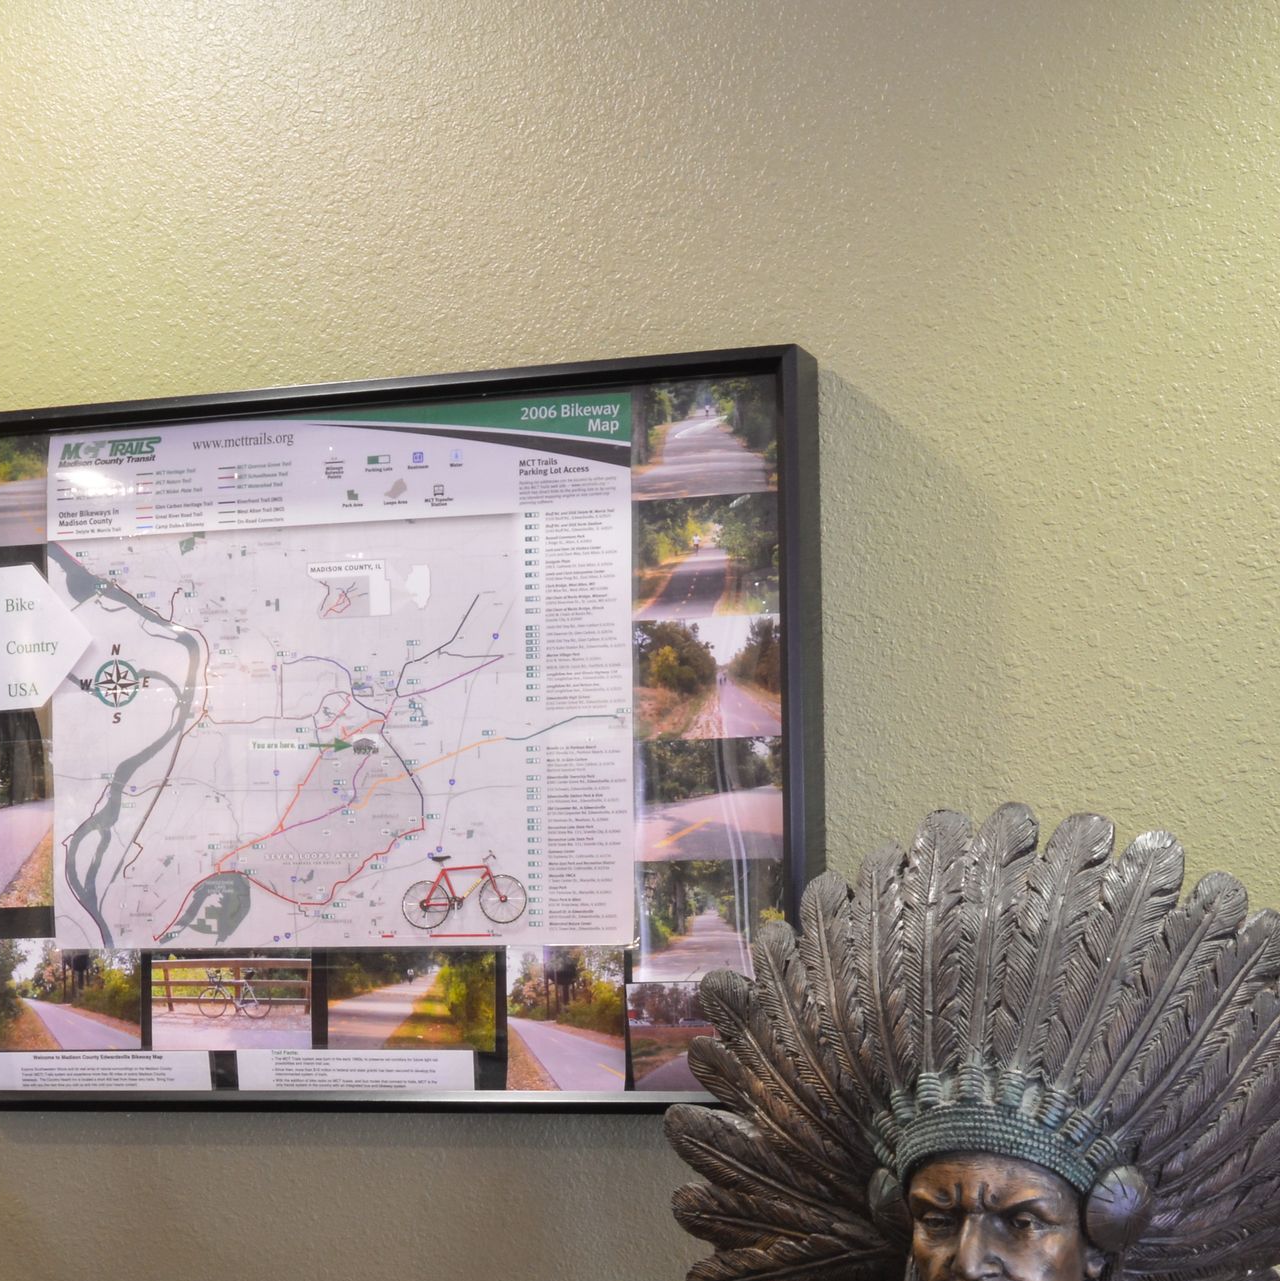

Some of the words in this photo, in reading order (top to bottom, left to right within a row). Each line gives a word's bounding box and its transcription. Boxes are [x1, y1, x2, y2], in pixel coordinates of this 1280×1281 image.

[521, 405, 557, 420] 2006
[561, 403, 620, 418] Bikeway
[588, 418, 619, 434] Map
[192, 432, 294, 451] www.mcttrails.org
[58, 459, 93, 468] Madison
[94, 455, 124, 466] County
[127, 454, 156, 464] Transit
[537, 458, 557, 466] Trails
[519, 468, 548, 477] Parking
[563, 465, 589, 473] Access
[58, 511, 78, 519] Other
[79, 509, 111, 518] Bikeways
[112, 507, 119, 515] in
[58, 518, 87, 527] Madison
[89, 518, 113, 526] County
[344, 564, 374, 572] COUNTY,
[5, 598, 35, 613] Bike
[6, 641, 59, 655] Country
[111, 644, 121, 656] N
[80, 679, 92, 690] W
[142, 676, 150, 688] E
[8, 684, 39, 698] USA
[112, 712, 122, 724] S
